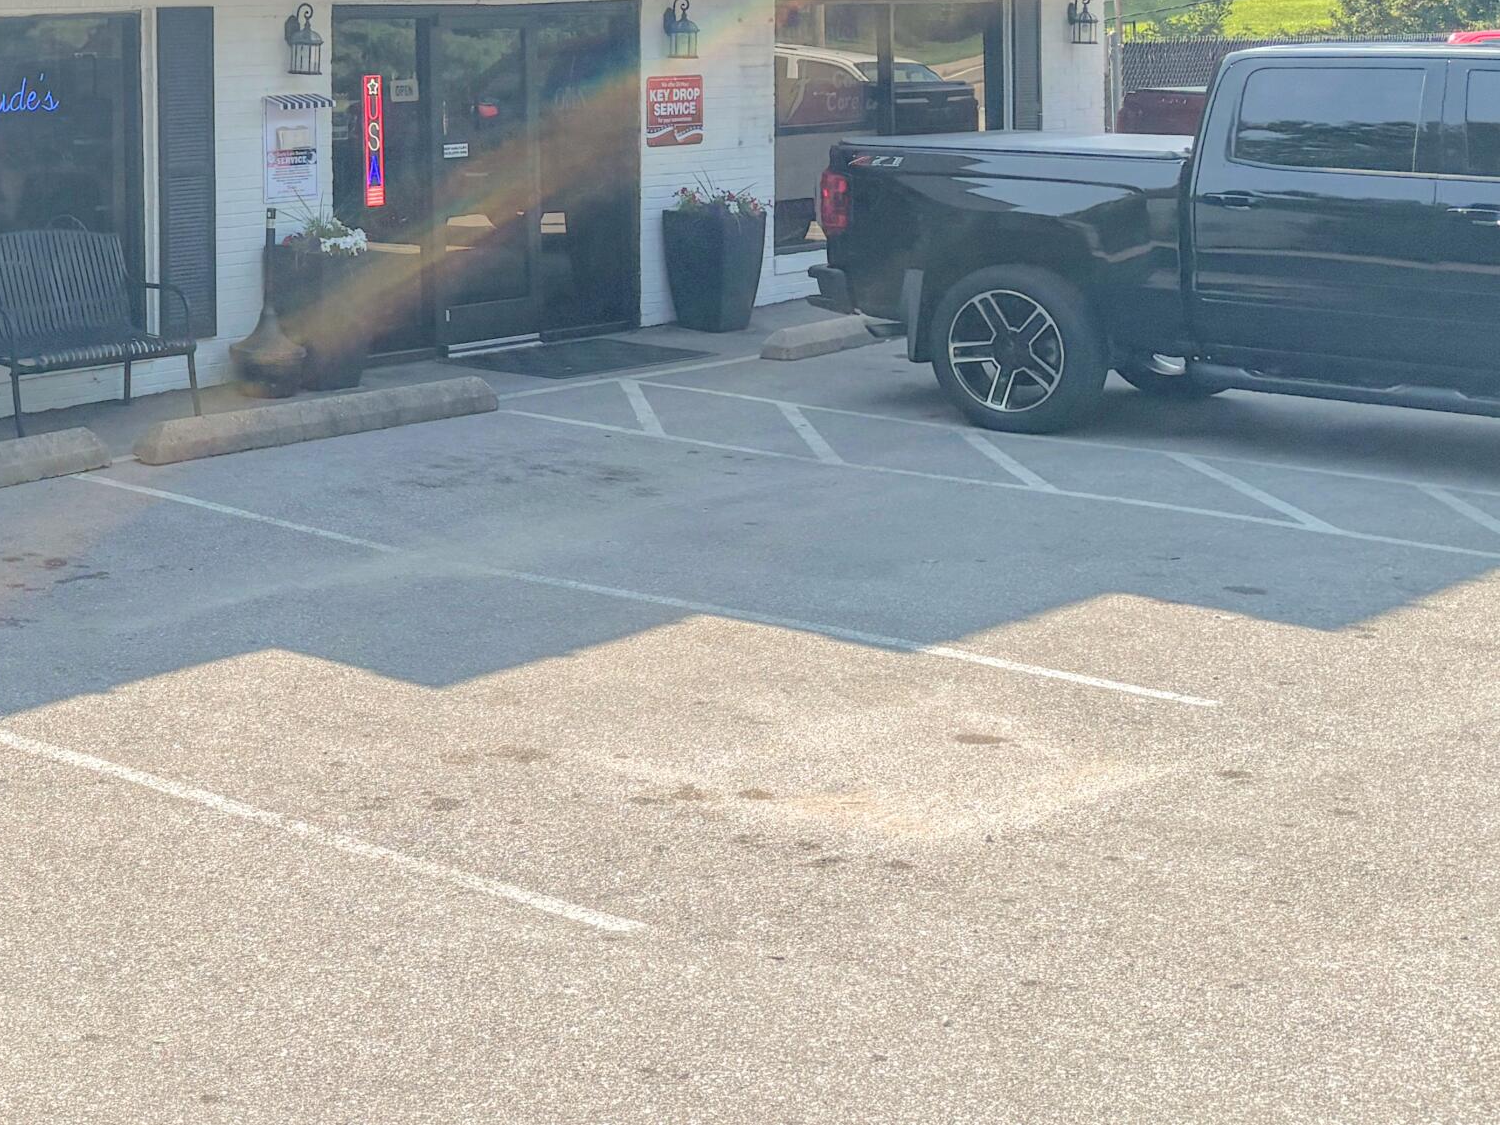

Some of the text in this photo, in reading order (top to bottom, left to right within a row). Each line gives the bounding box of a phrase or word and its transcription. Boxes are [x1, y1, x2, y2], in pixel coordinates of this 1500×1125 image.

[649, 87, 700, 102] KEY DROP
[654, 101, 696, 116] SERVICE
[367, 94, 382, 187] USA
[276, 156, 307, 165] SERVICE
